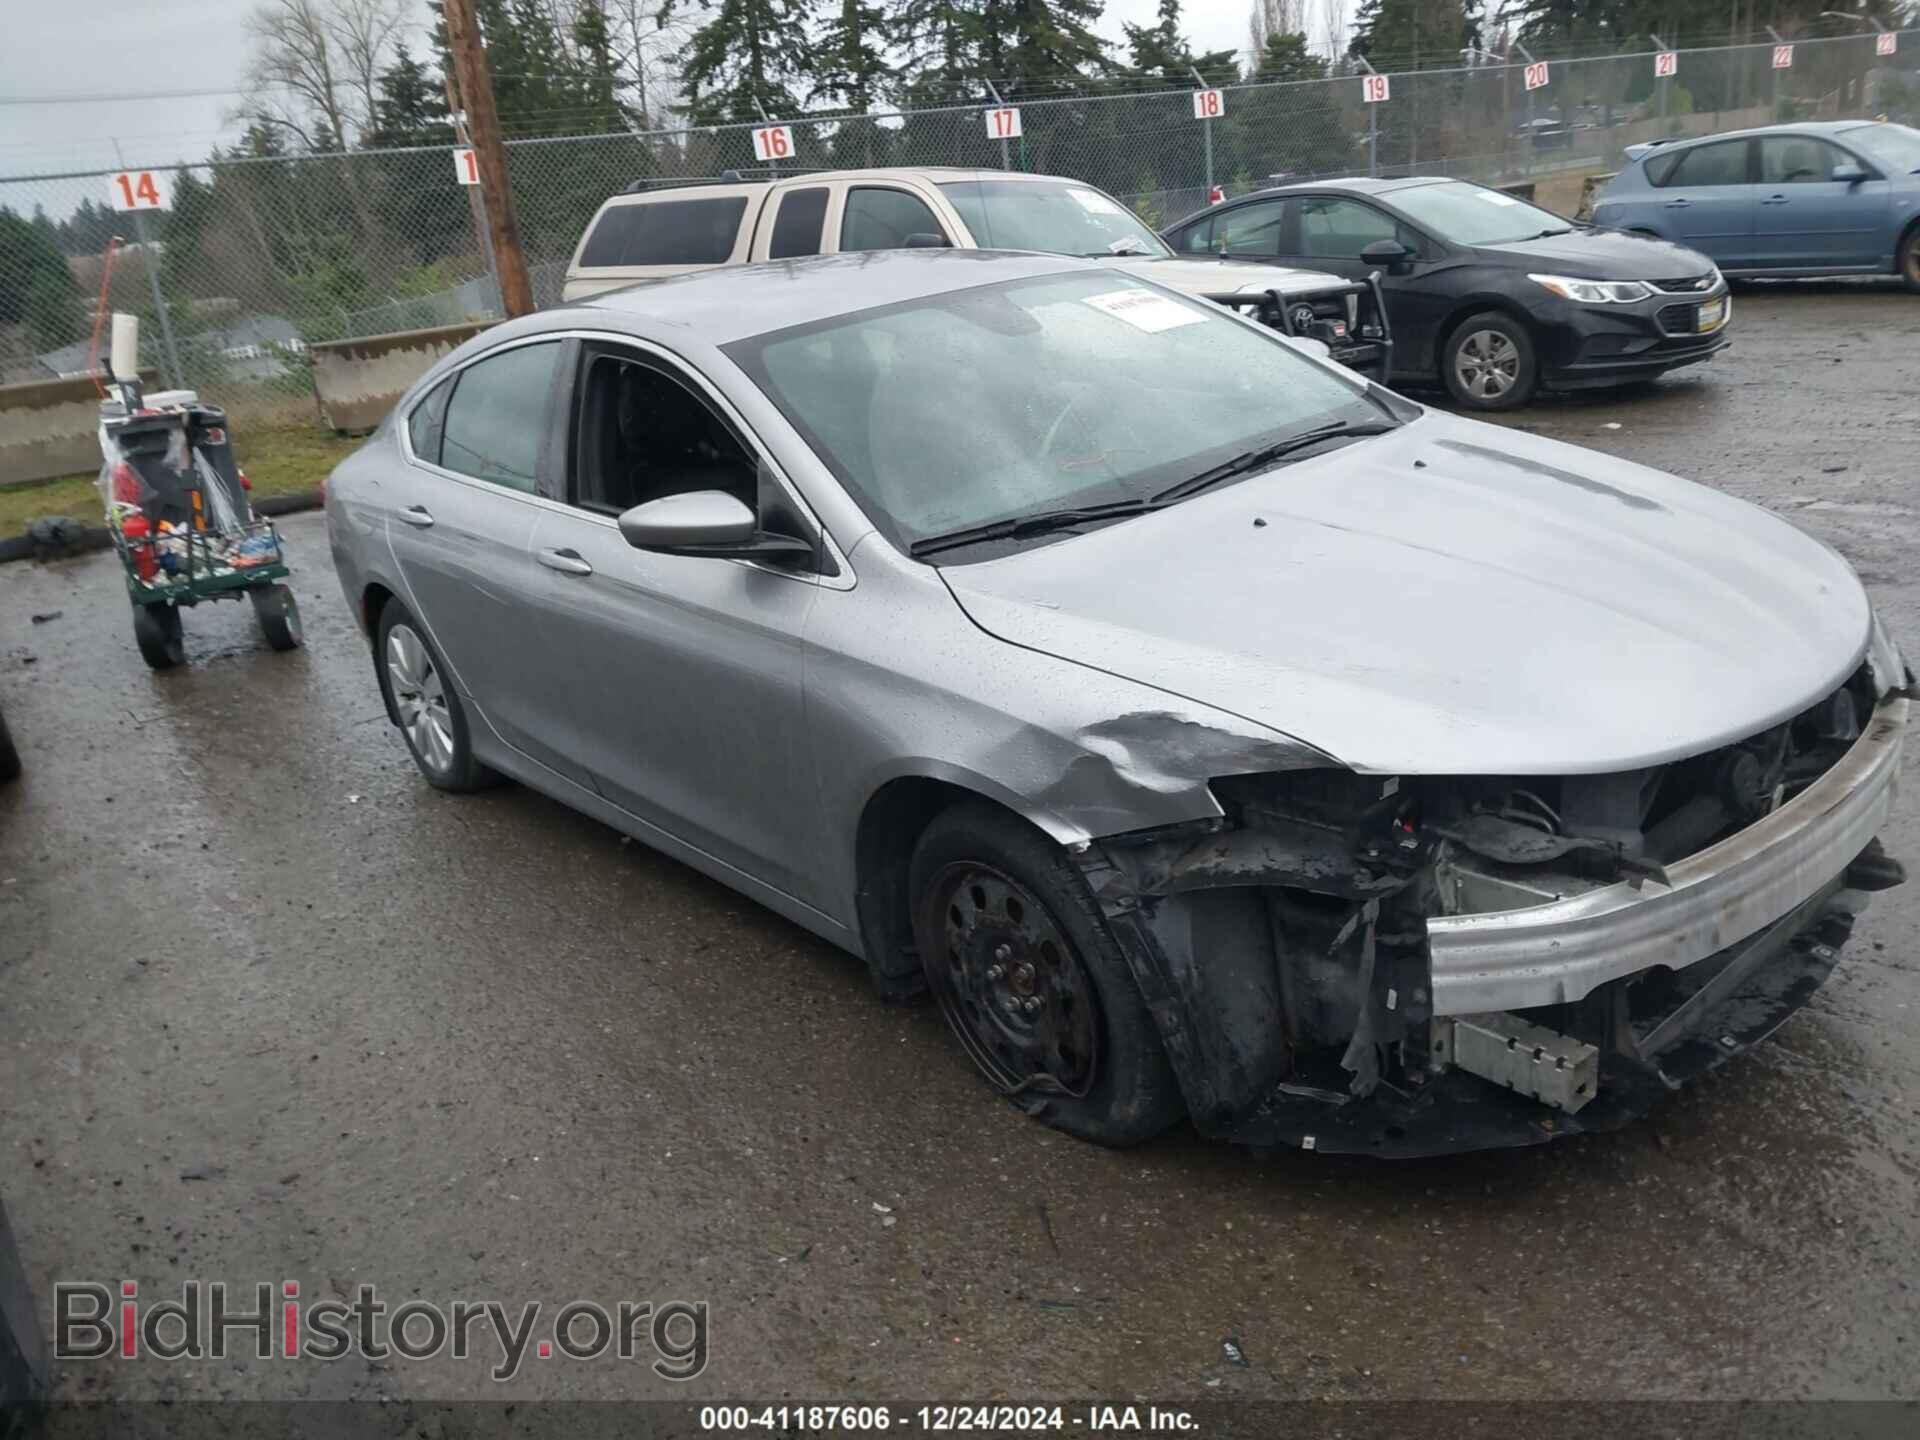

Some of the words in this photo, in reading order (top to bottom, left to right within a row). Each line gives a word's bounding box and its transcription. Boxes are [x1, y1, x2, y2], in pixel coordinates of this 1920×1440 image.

[1659, 54, 1674, 75] 21
[1775, 46, 1791, 66] 22
[1367, 77, 1386, 100] 19
[1527, 64, 1546, 89] 20
[1199, 92, 1219, 117] 18
[994, 111, 1014, 136] 17
[760, 128, 787, 158] 16
[117, 172, 161, 208] 14
